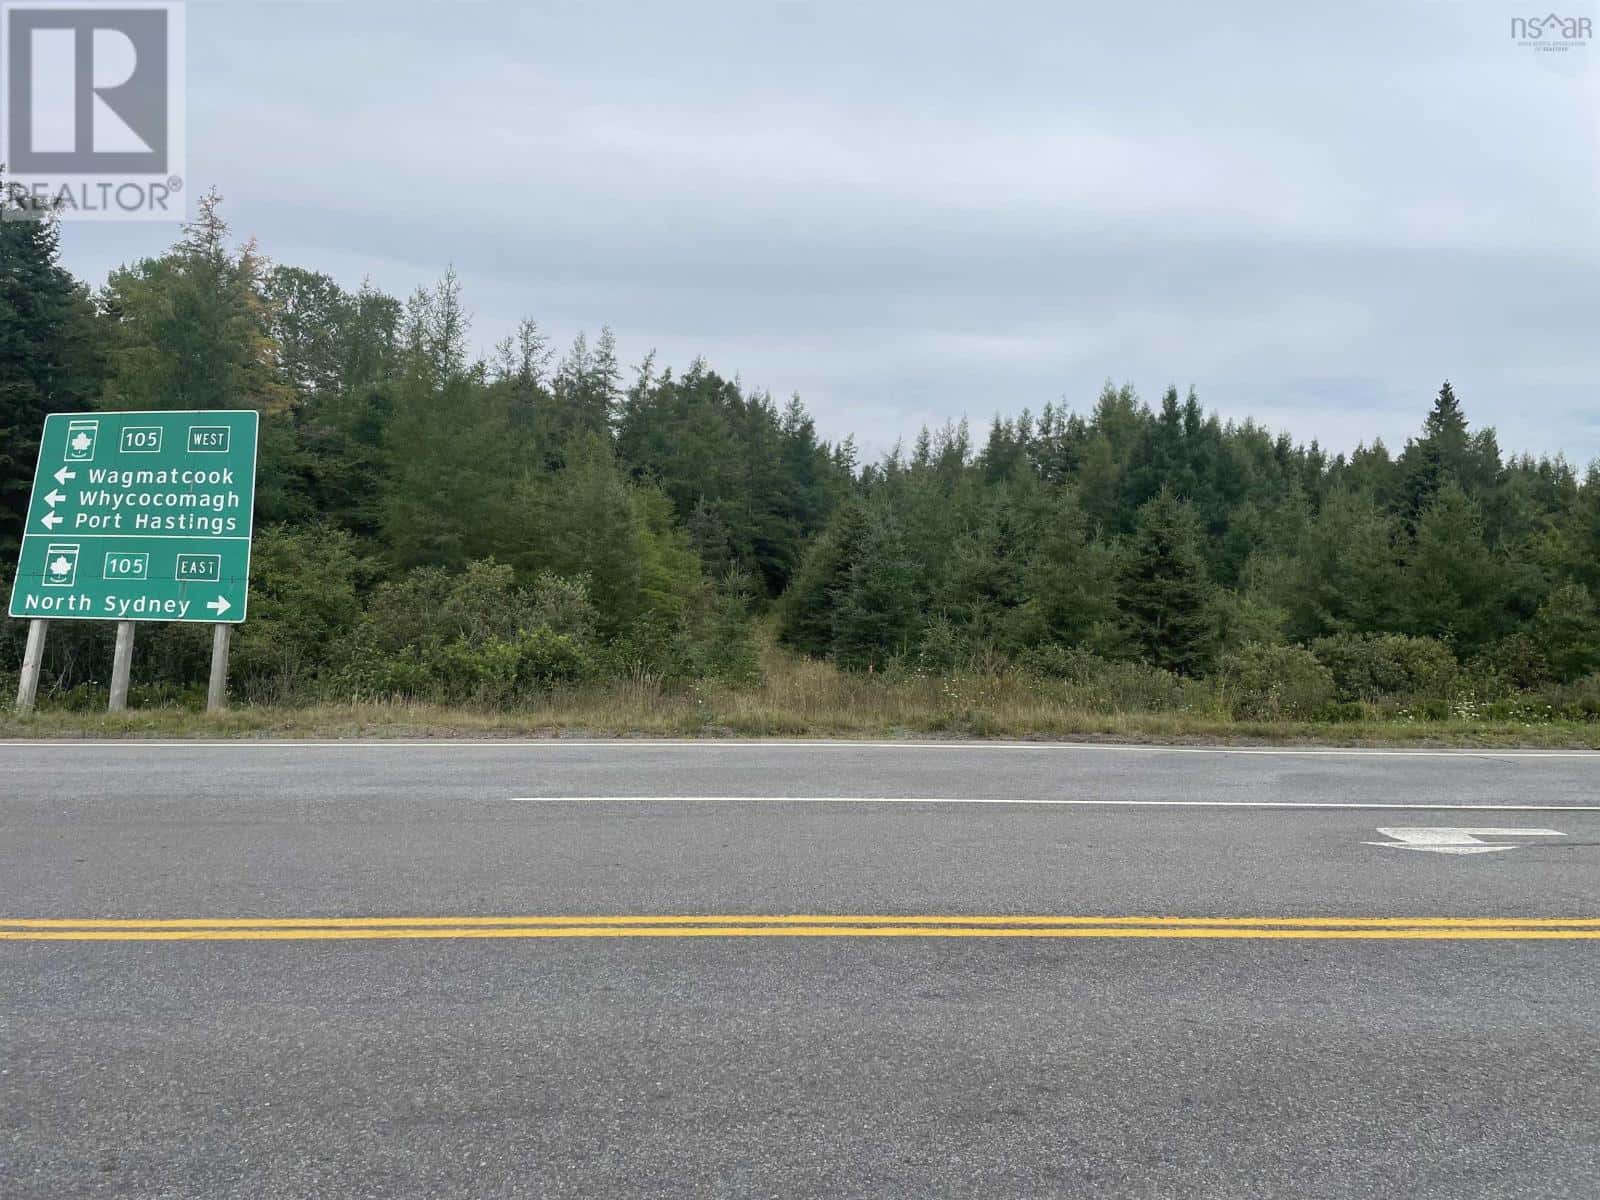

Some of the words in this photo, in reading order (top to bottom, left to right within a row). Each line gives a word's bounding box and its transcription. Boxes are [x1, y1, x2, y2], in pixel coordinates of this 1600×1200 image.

[125, 432, 158, 447] 105
[193, 432, 224, 446] WEST
[89, 467, 234, 488] Wagmatcook
[79, 490, 239, 512] Whycocomagh
[75, 512, 123, 529] Port
[135, 513, 236, 535] Hastings
[109, 558, 144, 574] 105
[181, 561, 215, 575] EAST
[25, 594, 91, 611] North
[104, 595, 191, 618] Sydney
